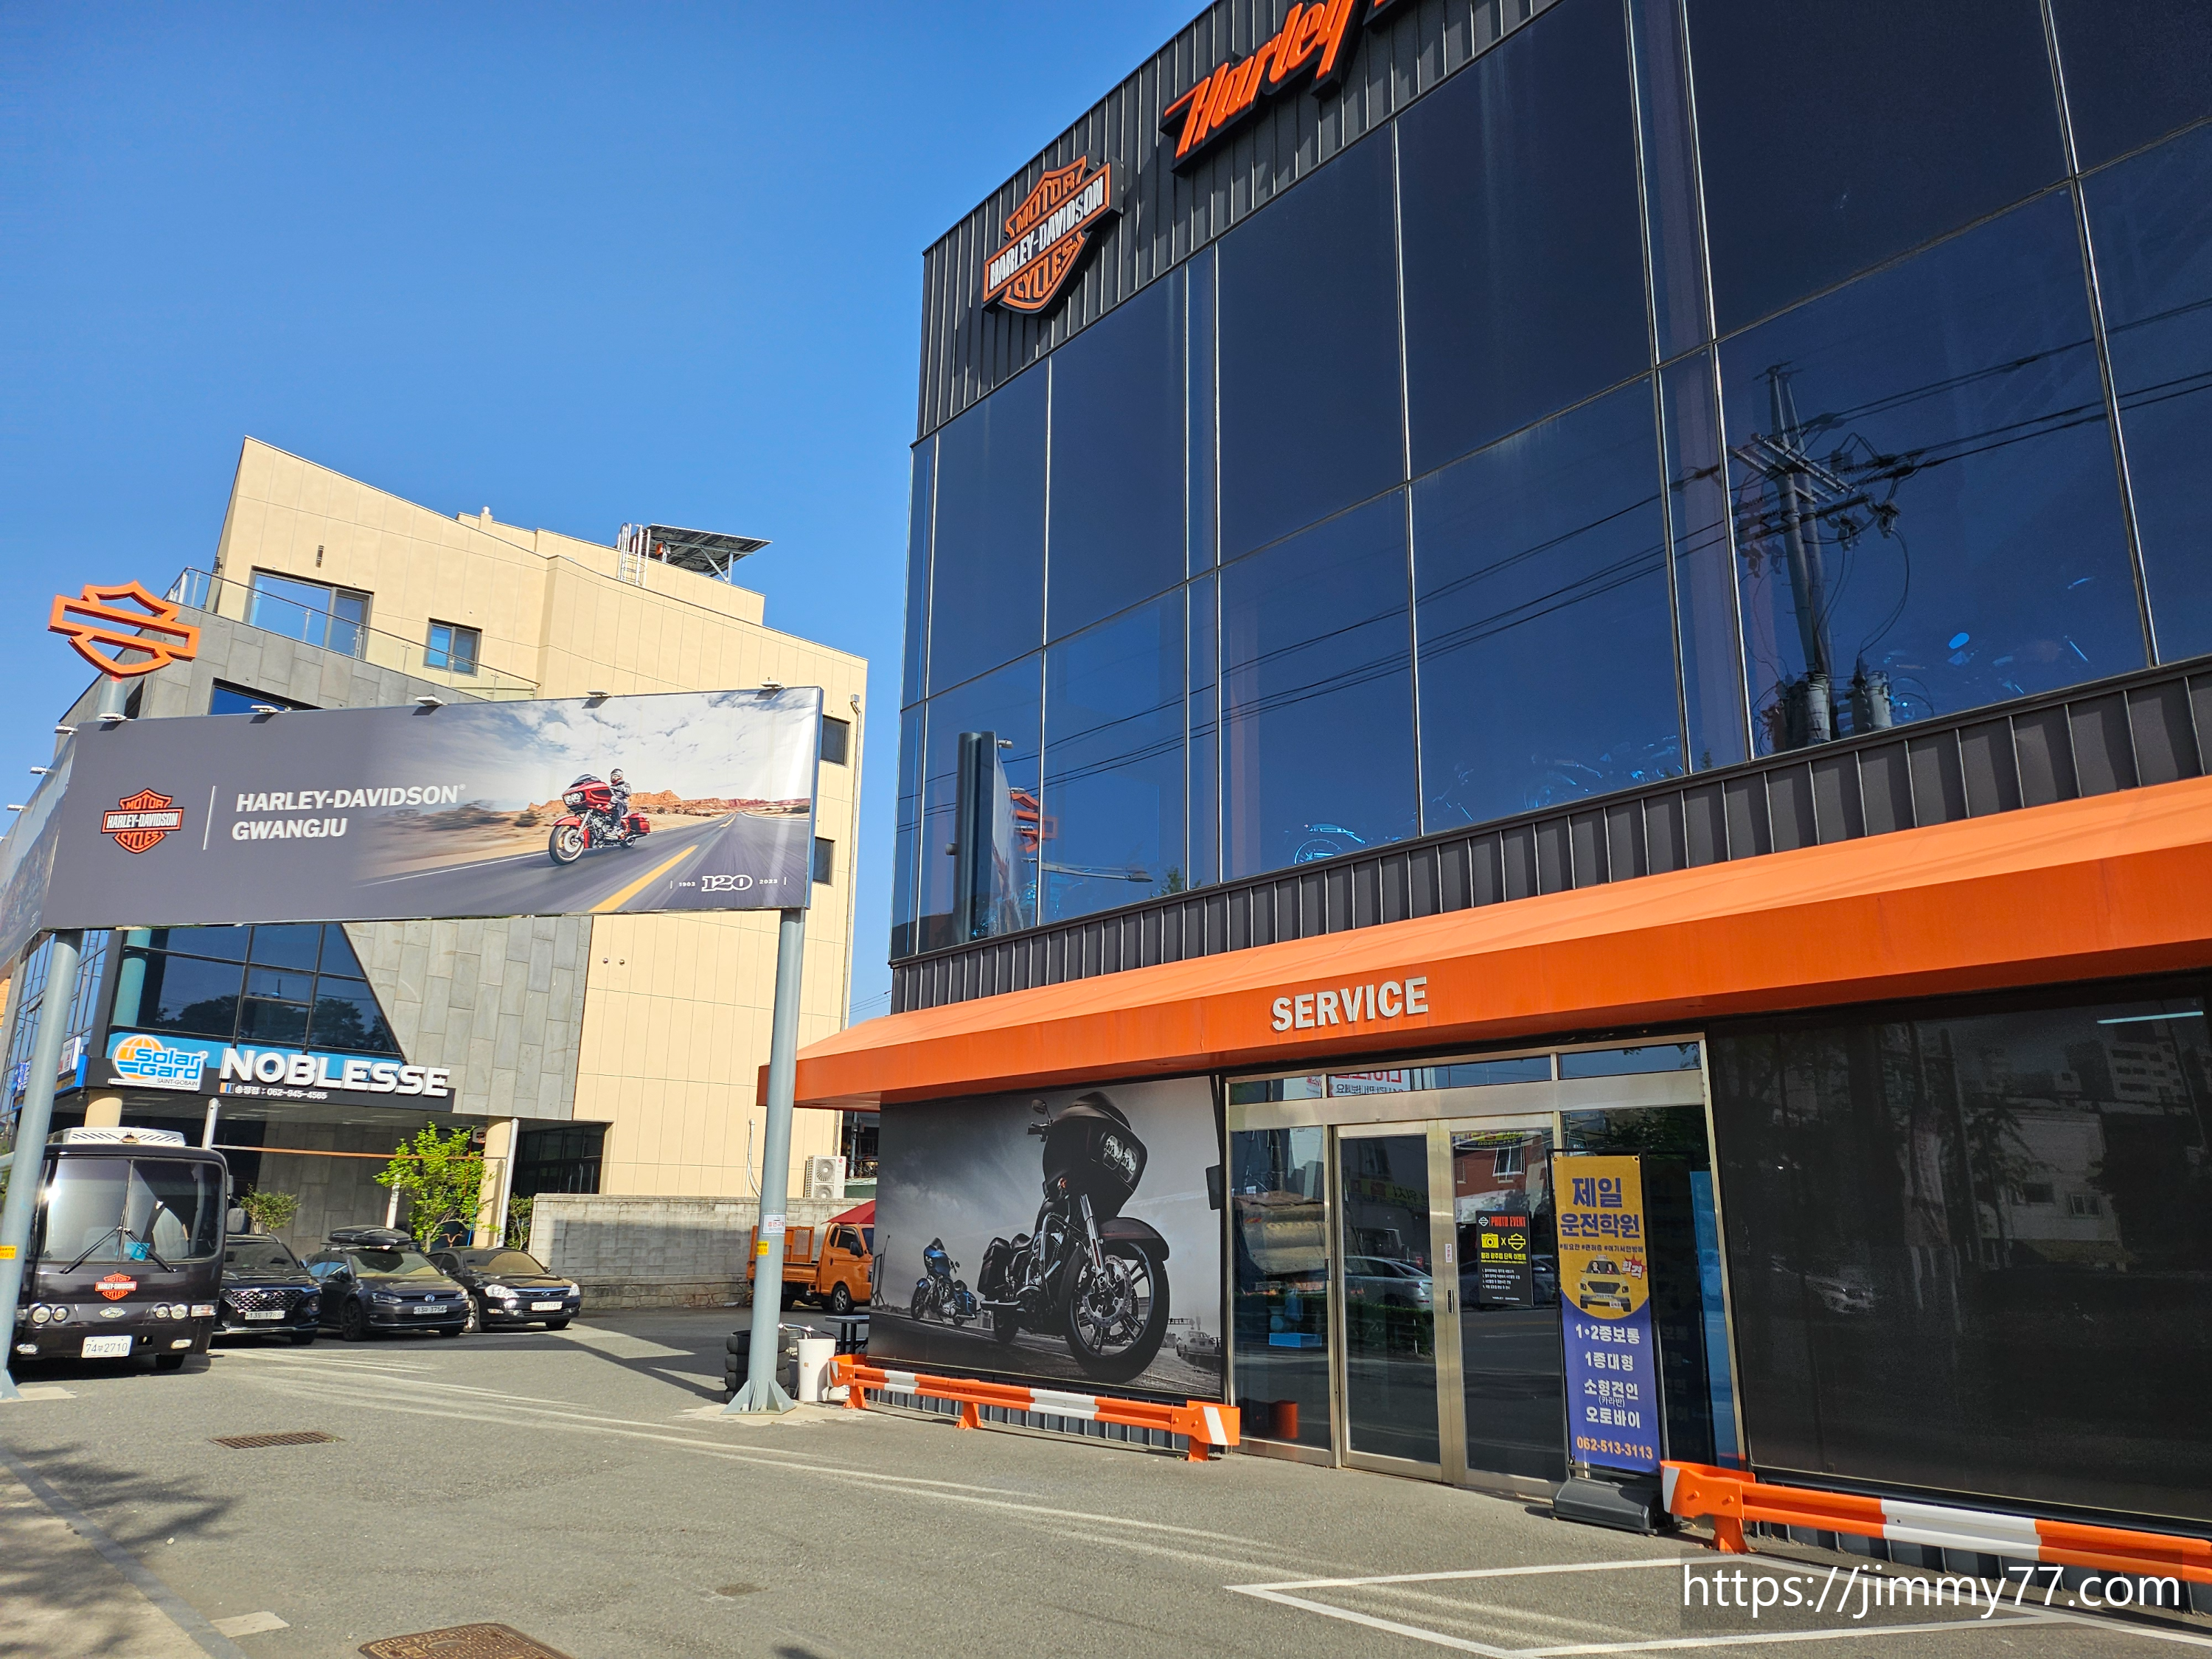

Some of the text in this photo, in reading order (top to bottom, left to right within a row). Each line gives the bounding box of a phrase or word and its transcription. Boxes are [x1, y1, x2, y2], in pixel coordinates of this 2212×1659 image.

[1164, 0, 1354, 159] Harley
[1016, 171, 1075, 234] MOTOR
[990, 175, 1104, 291] HARLEY-DAVIDSON
[1013, 237, 1074, 299] CYCLES
[125, 793, 164, 810] MOTOR
[236, 785, 459, 812] HARLEY-DAVIDSON
[105, 812, 178, 829] HARLEY-DAVIDSON
[232, 818, 348, 841] GWANGJU
[120, 831, 159, 849] CYCLES
[701, 874, 754, 891] 120
[1272, 976, 1428, 1031] SERVICE
[135, 1048, 201, 1066] Solar
[139, 1061, 201, 1079] Gard
[219, 1048, 451, 1097] NOBLESSE
[156, 1078, 198, 1086] SAINT-GOBAIN
[1571, 1178, 1622, 1208] 제일
[1509, 1216, 1526, 1227] EVENT
[1560, 1213, 1640, 1239] 운전학원
[1585, 1352, 1634, 1371] 1종대형
[1585, 1378, 1639, 1400] 소형견인
[1599, 1396, 1625, 1408] (카라반)
[1586, 1407, 1641, 1429] 오토바이
[1576, 1436, 1653, 1460] 062-513-3113
